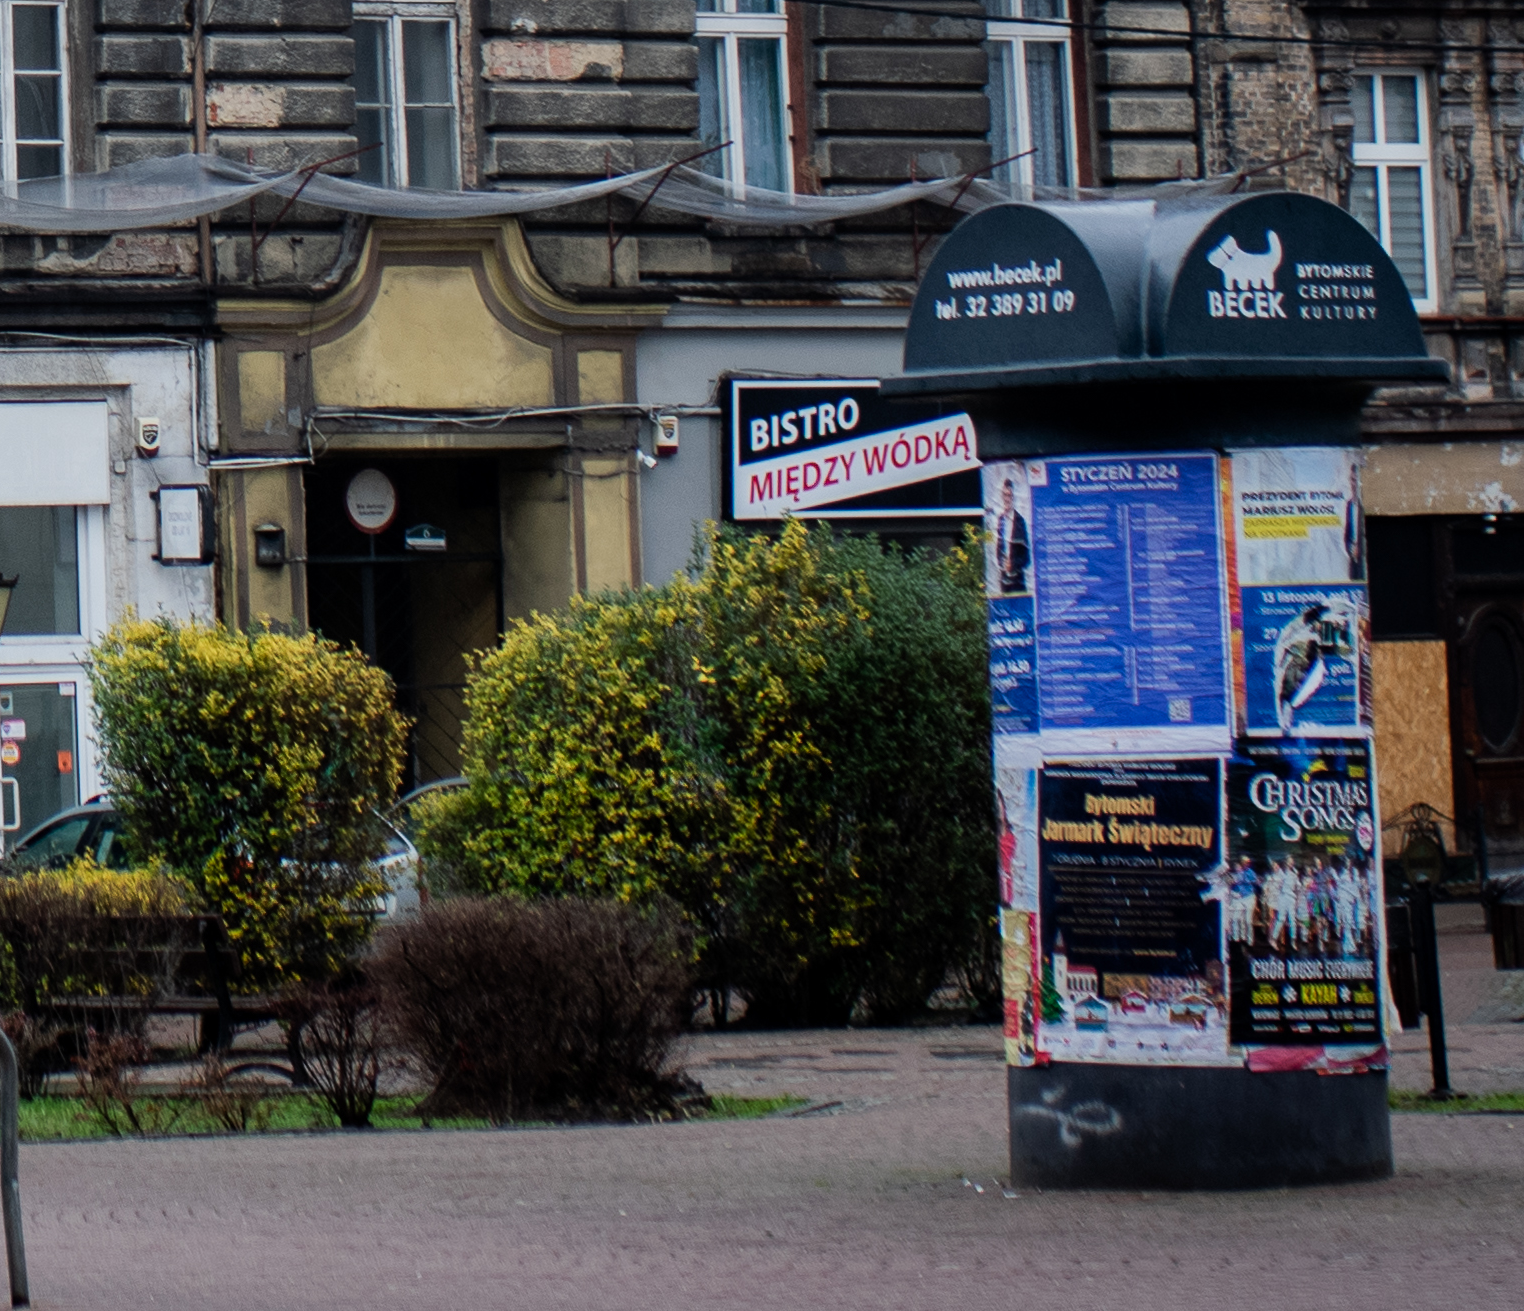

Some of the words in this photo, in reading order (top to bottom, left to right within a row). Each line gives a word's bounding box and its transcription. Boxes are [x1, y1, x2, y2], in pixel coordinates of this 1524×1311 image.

[946, 257, 1062, 289] www.becek.pl
[1295, 263, 1374, 279] BYTOMSKIE
[935, 296, 961, 320] tel.
[965, 294, 987, 318] 32
[990, 292, 1023, 316] 389
[1026, 291, 1047, 314] 31
[1052, 289, 1075, 312] 09
[1207, 289, 1287, 319] BECEK
[1297, 284, 1376, 299] CENTRUM
[1299, 305, 1377, 320] KULTURY
[750, 397, 860, 452] BISTRO
[749, 451, 857, 504] MIĘDZY
[863, 425, 971, 477] WÓDKĄ
[1060, 462, 1133, 482] STYCZEŃ
[1136, 463, 1179, 479] 2024
[1085, 793, 1156, 816] Bytomski
[1249, 772, 1368, 813] CHRISTMAS
[1042, 817, 1105, 843] Jarmark
[1107, 815, 1214, 852] Świąteczny
[1280, 806, 1356, 842] SONGS
[1287, 958, 1323, 979] MUSIC
[1300, 982, 1338, 1005] KAYAH
